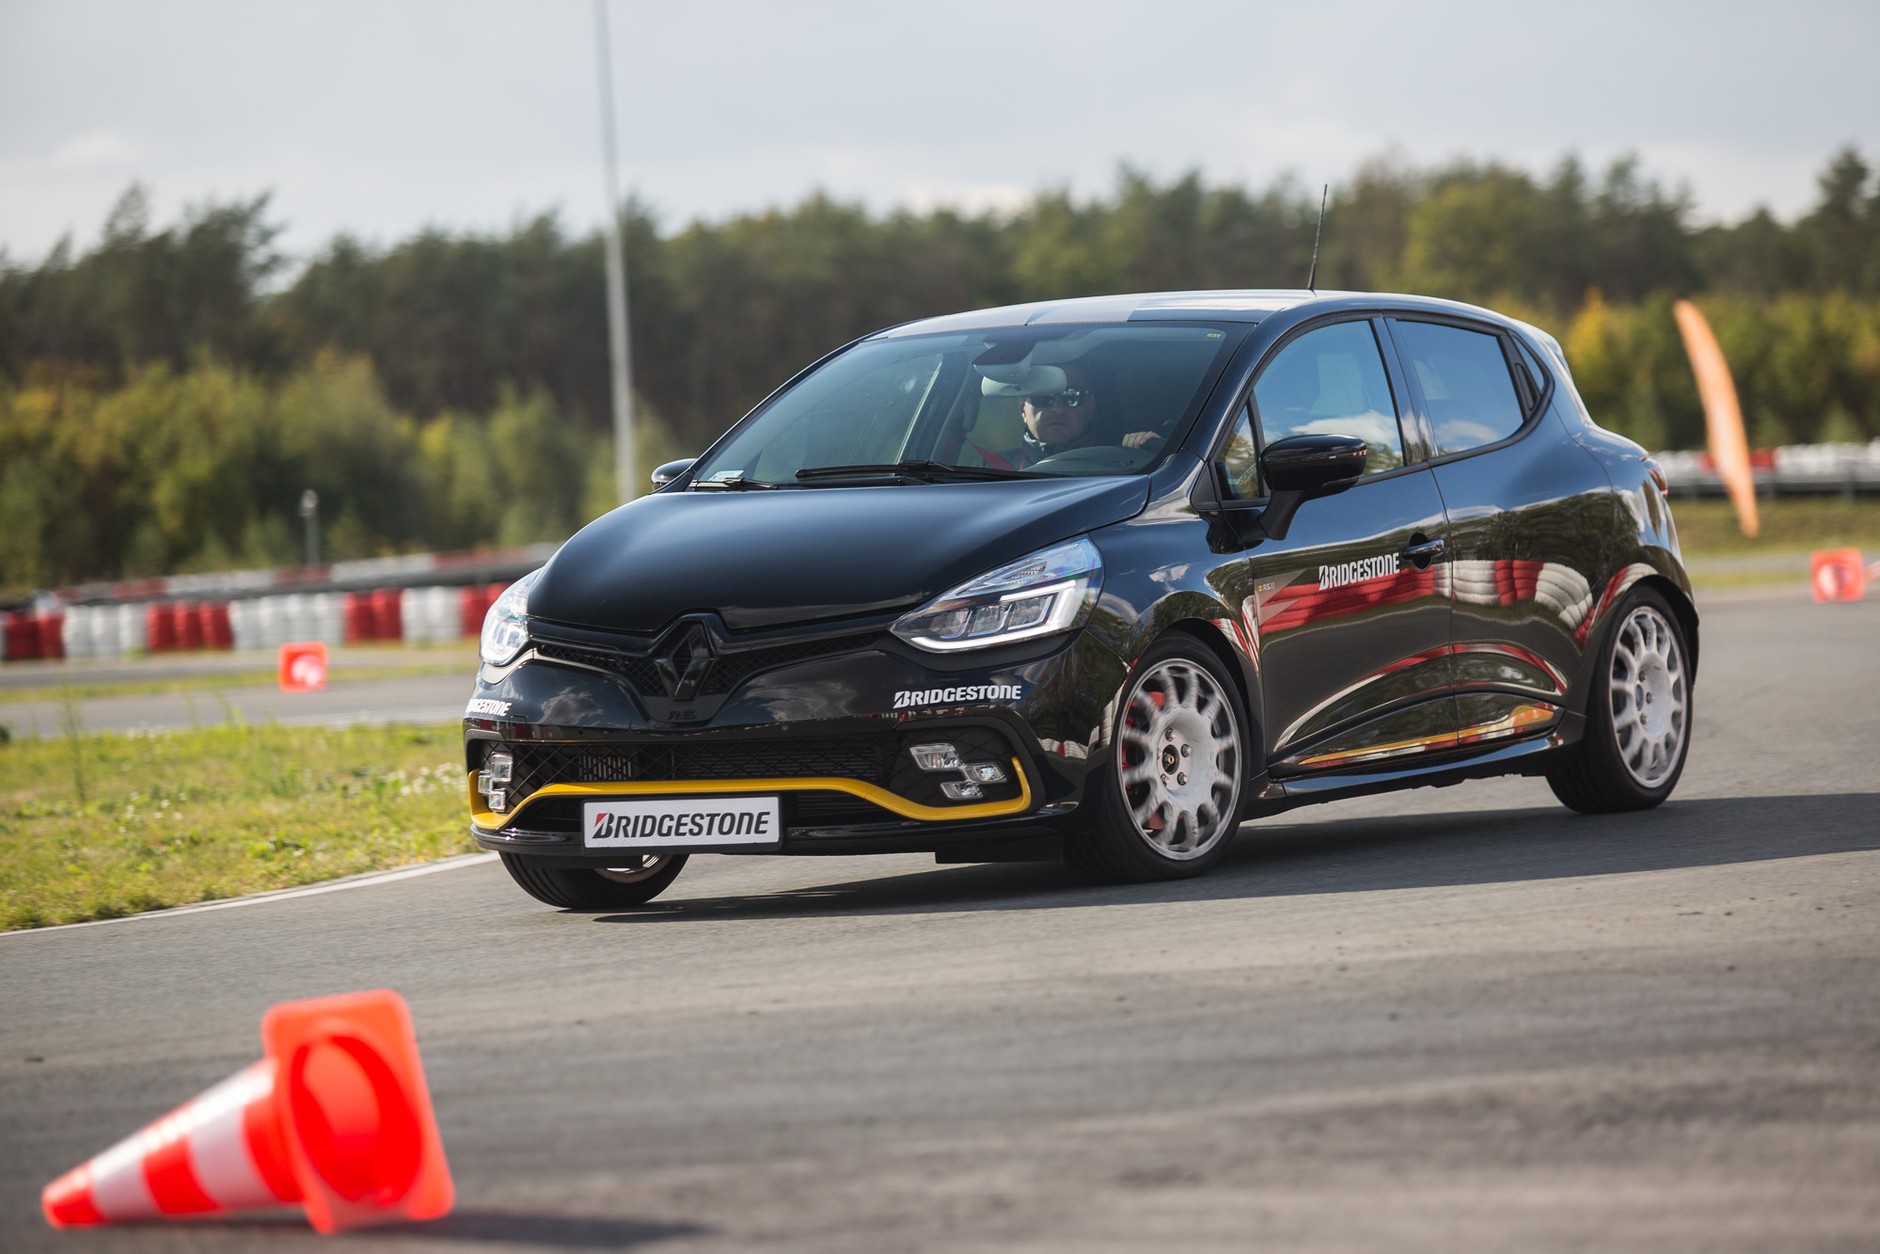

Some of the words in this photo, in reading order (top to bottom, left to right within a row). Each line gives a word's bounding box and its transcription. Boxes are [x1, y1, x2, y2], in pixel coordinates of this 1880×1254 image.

[1318, 552, 1400, 591] BRIDGESTONE
[892, 685, 1022, 709] BRIDGESTONE
[592, 812, 771, 839] BRIDGESTONE
